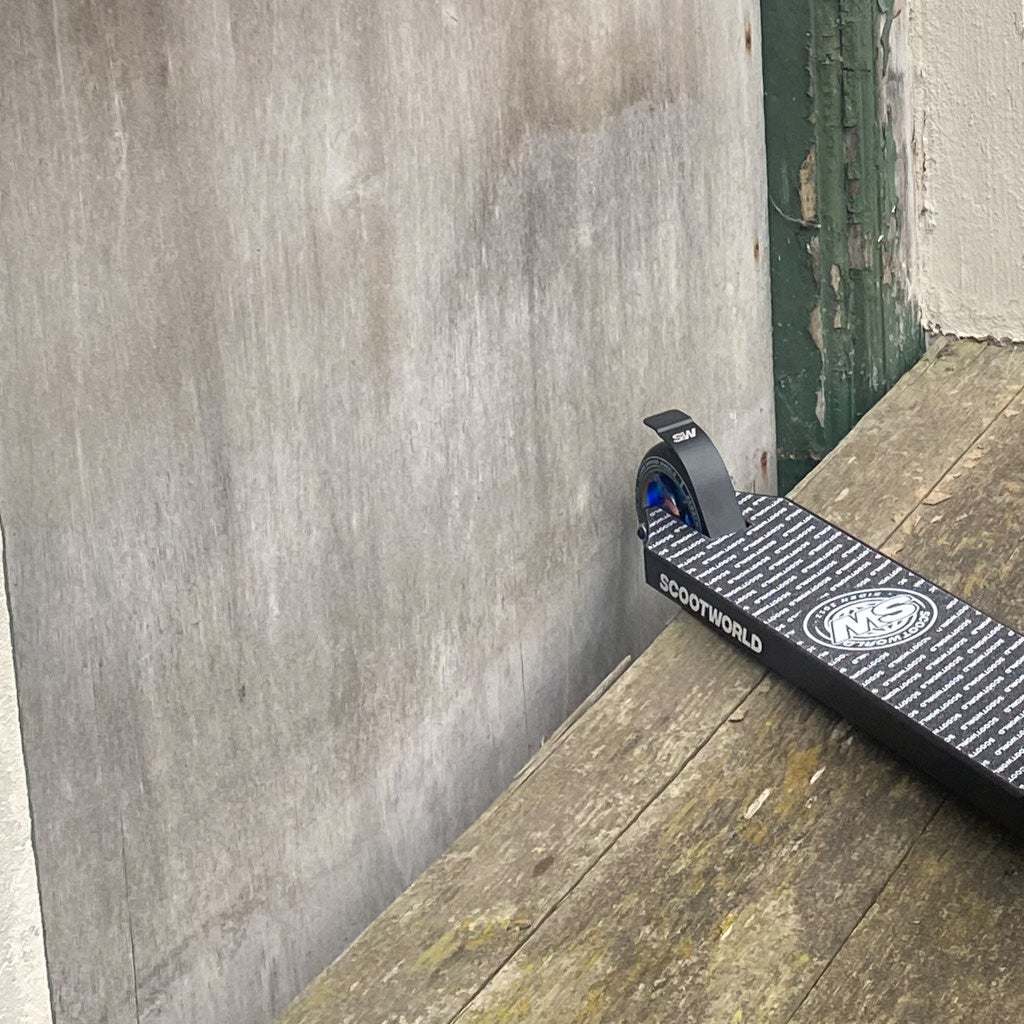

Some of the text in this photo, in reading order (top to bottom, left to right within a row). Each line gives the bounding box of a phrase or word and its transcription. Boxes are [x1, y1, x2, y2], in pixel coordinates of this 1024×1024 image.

[672, 427, 697, 443] SW
[660, 574, 762, 654] SCOOTWORLD
[830, 595, 917, 644] SW
[842, 610, 930, 647] SCOOTWORLD
